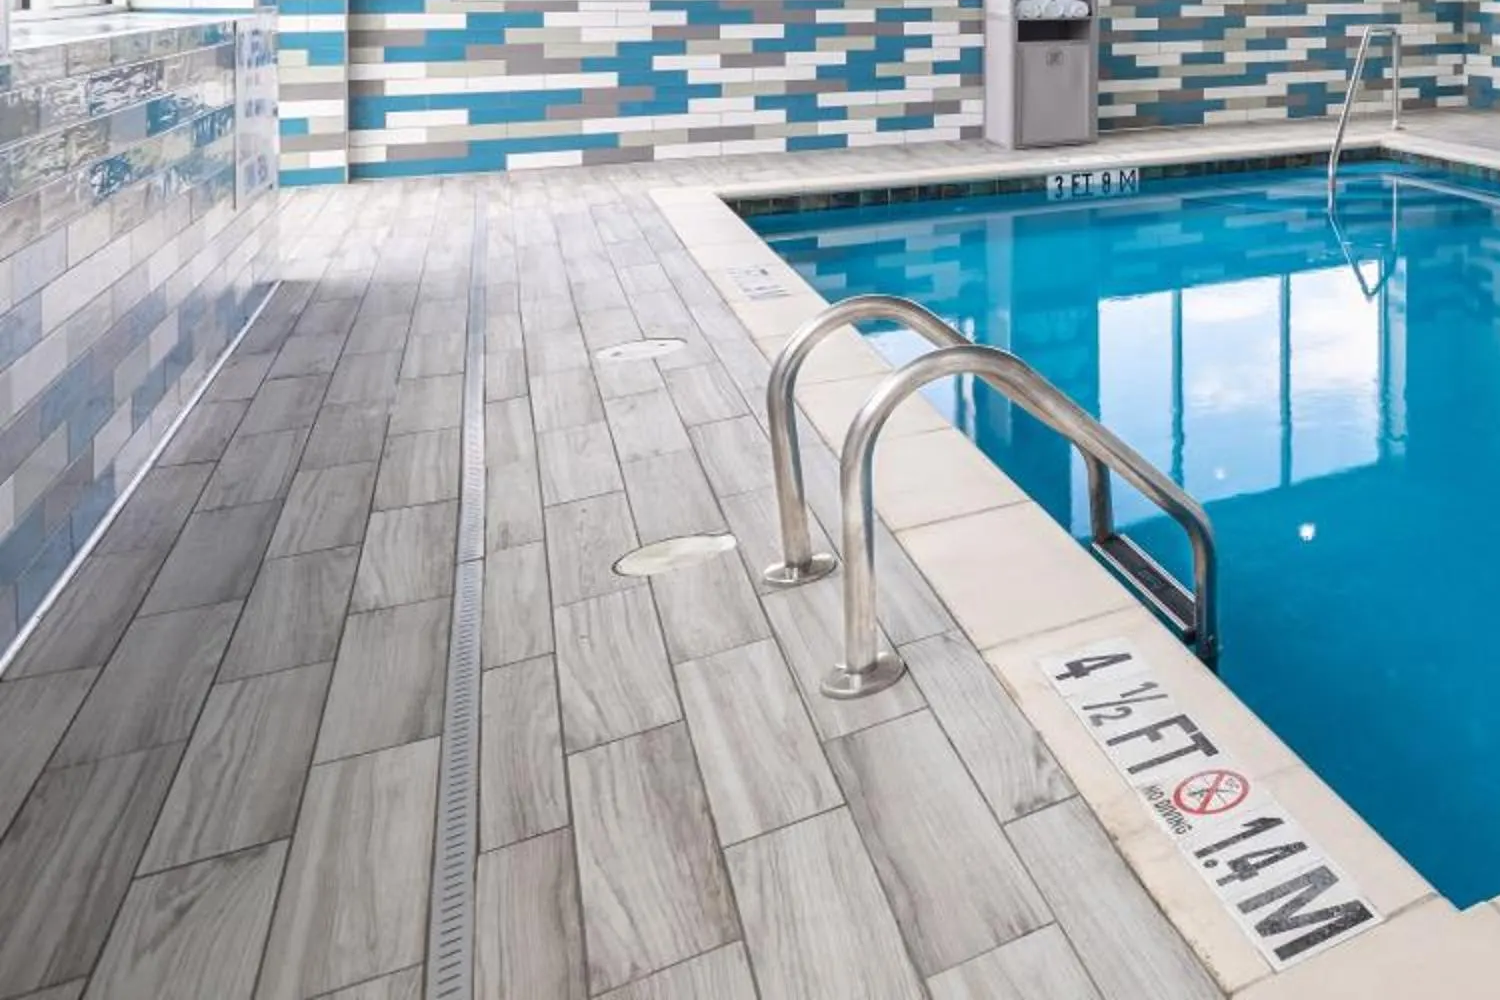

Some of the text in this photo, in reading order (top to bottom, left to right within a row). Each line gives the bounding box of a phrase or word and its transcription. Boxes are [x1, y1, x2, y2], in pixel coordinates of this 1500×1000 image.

[1055, 652, 1132, 681] 4
[1106, 713, 1220, 775] FT
[1141, 784, 1193, 835] NO DIVING
